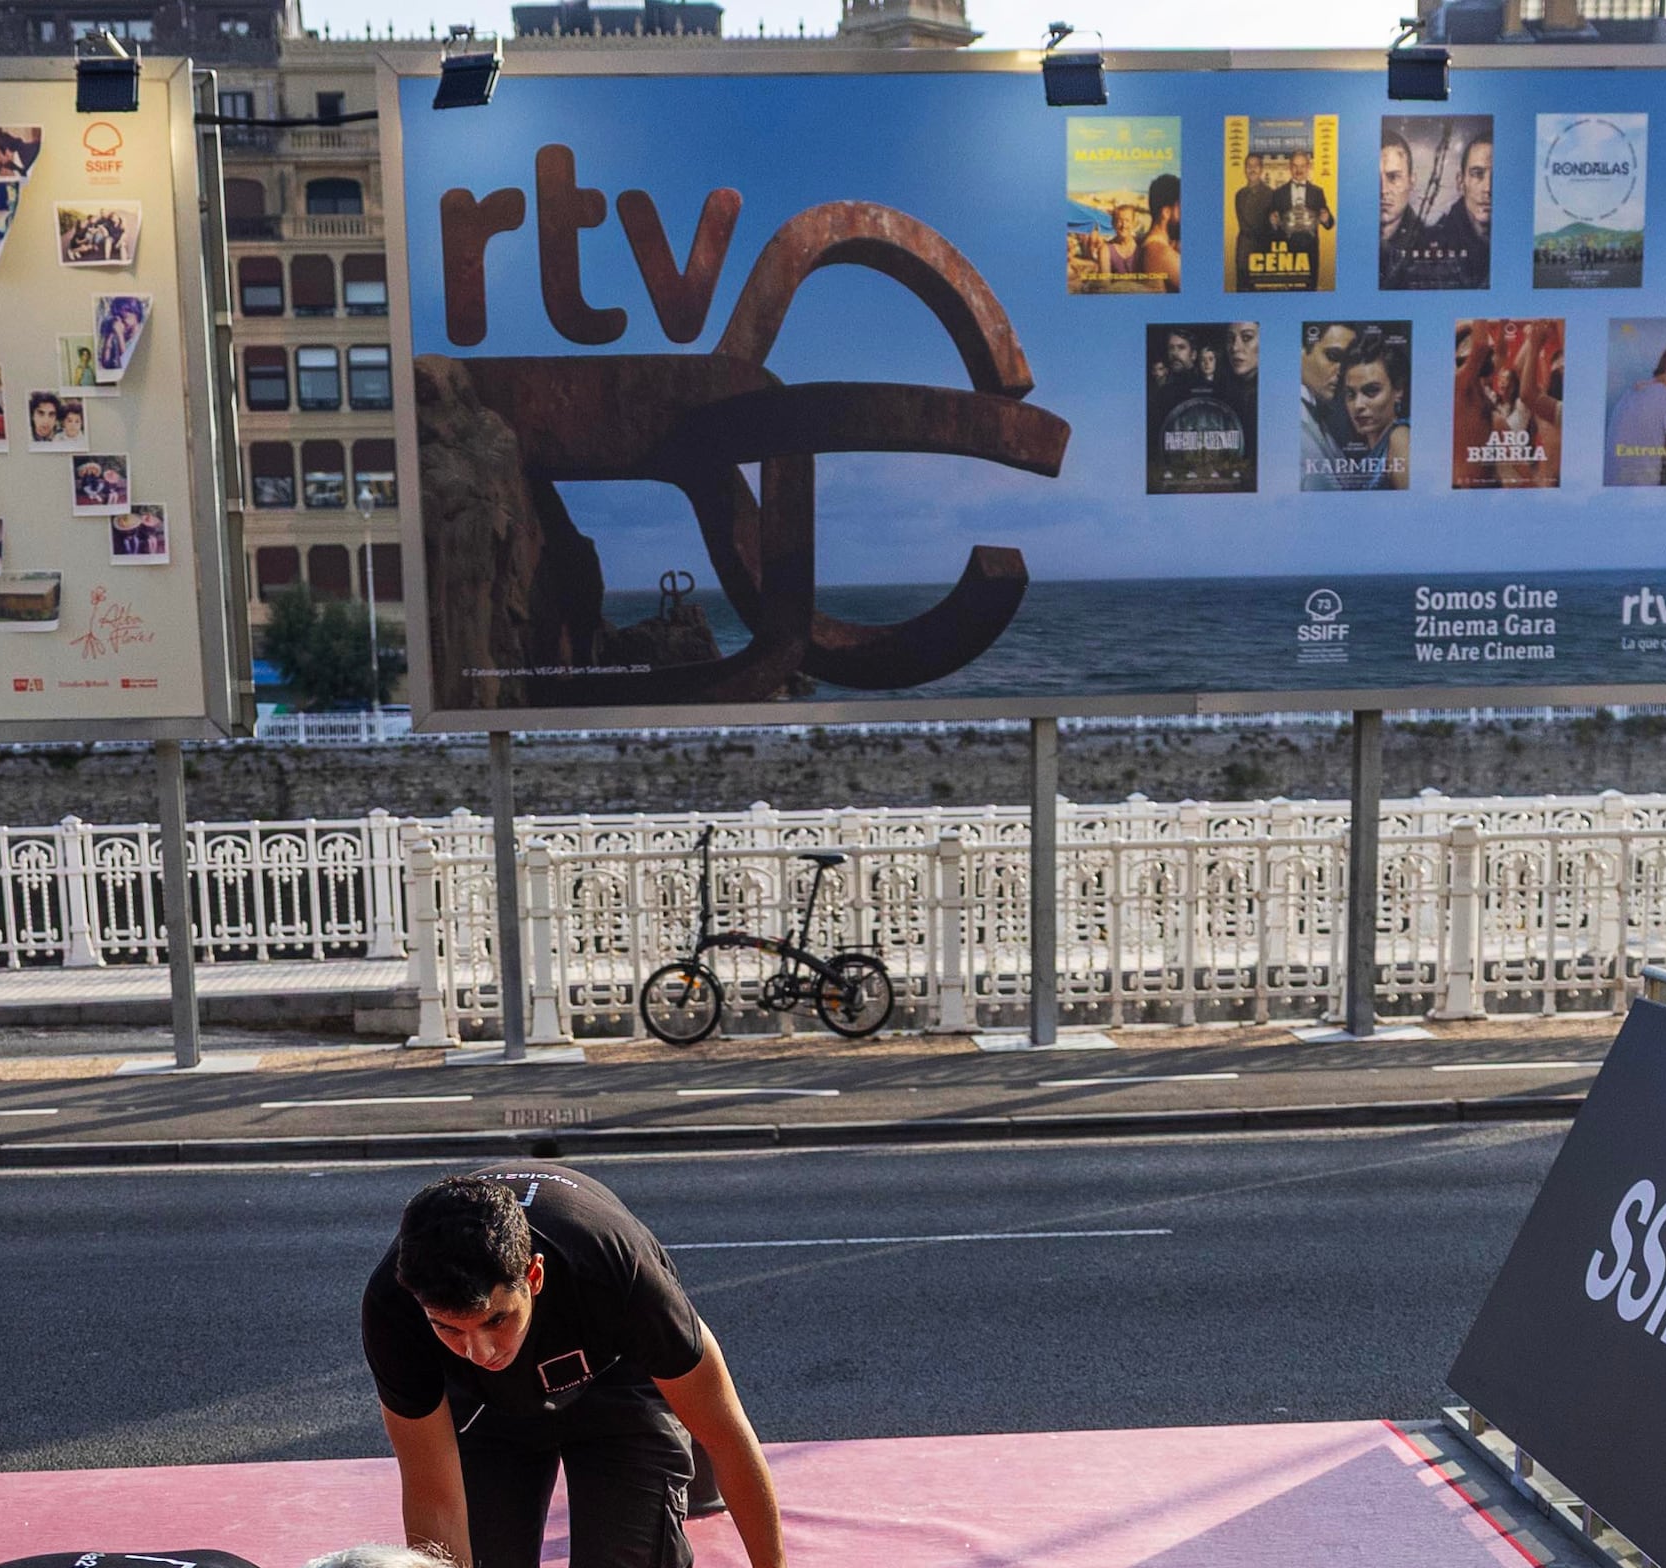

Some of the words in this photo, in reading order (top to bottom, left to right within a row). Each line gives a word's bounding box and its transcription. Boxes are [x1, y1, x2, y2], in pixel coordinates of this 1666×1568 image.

[1074, 148, 1173, 161] MASPALOMAS
[85, 160, 123, 172] SSIFF
[1271, 241, 1288, 252] LA
[1248, 252, 1311, 272] CENA
[1486, 430, 1531, 446] ARO
[1467, 446, 1548, 462] BERRIA
[1305, 457, 1406, 475] KARMELE
[1415, 586, 1496, 611] Somos
[1503, 584, 1558, 609] Cine
[1297, 624, 1349, 641] SSIFF
[1415, 615, 1499, 637] Zinema
[1504, 614, 1556, 635] Gara
[1415, 643, 1443, 662] We
[1446, 643, 1481, 661] Are
[1484, 641, 1556, 660] Cinema
[1637, 639, 1660, 652] que
